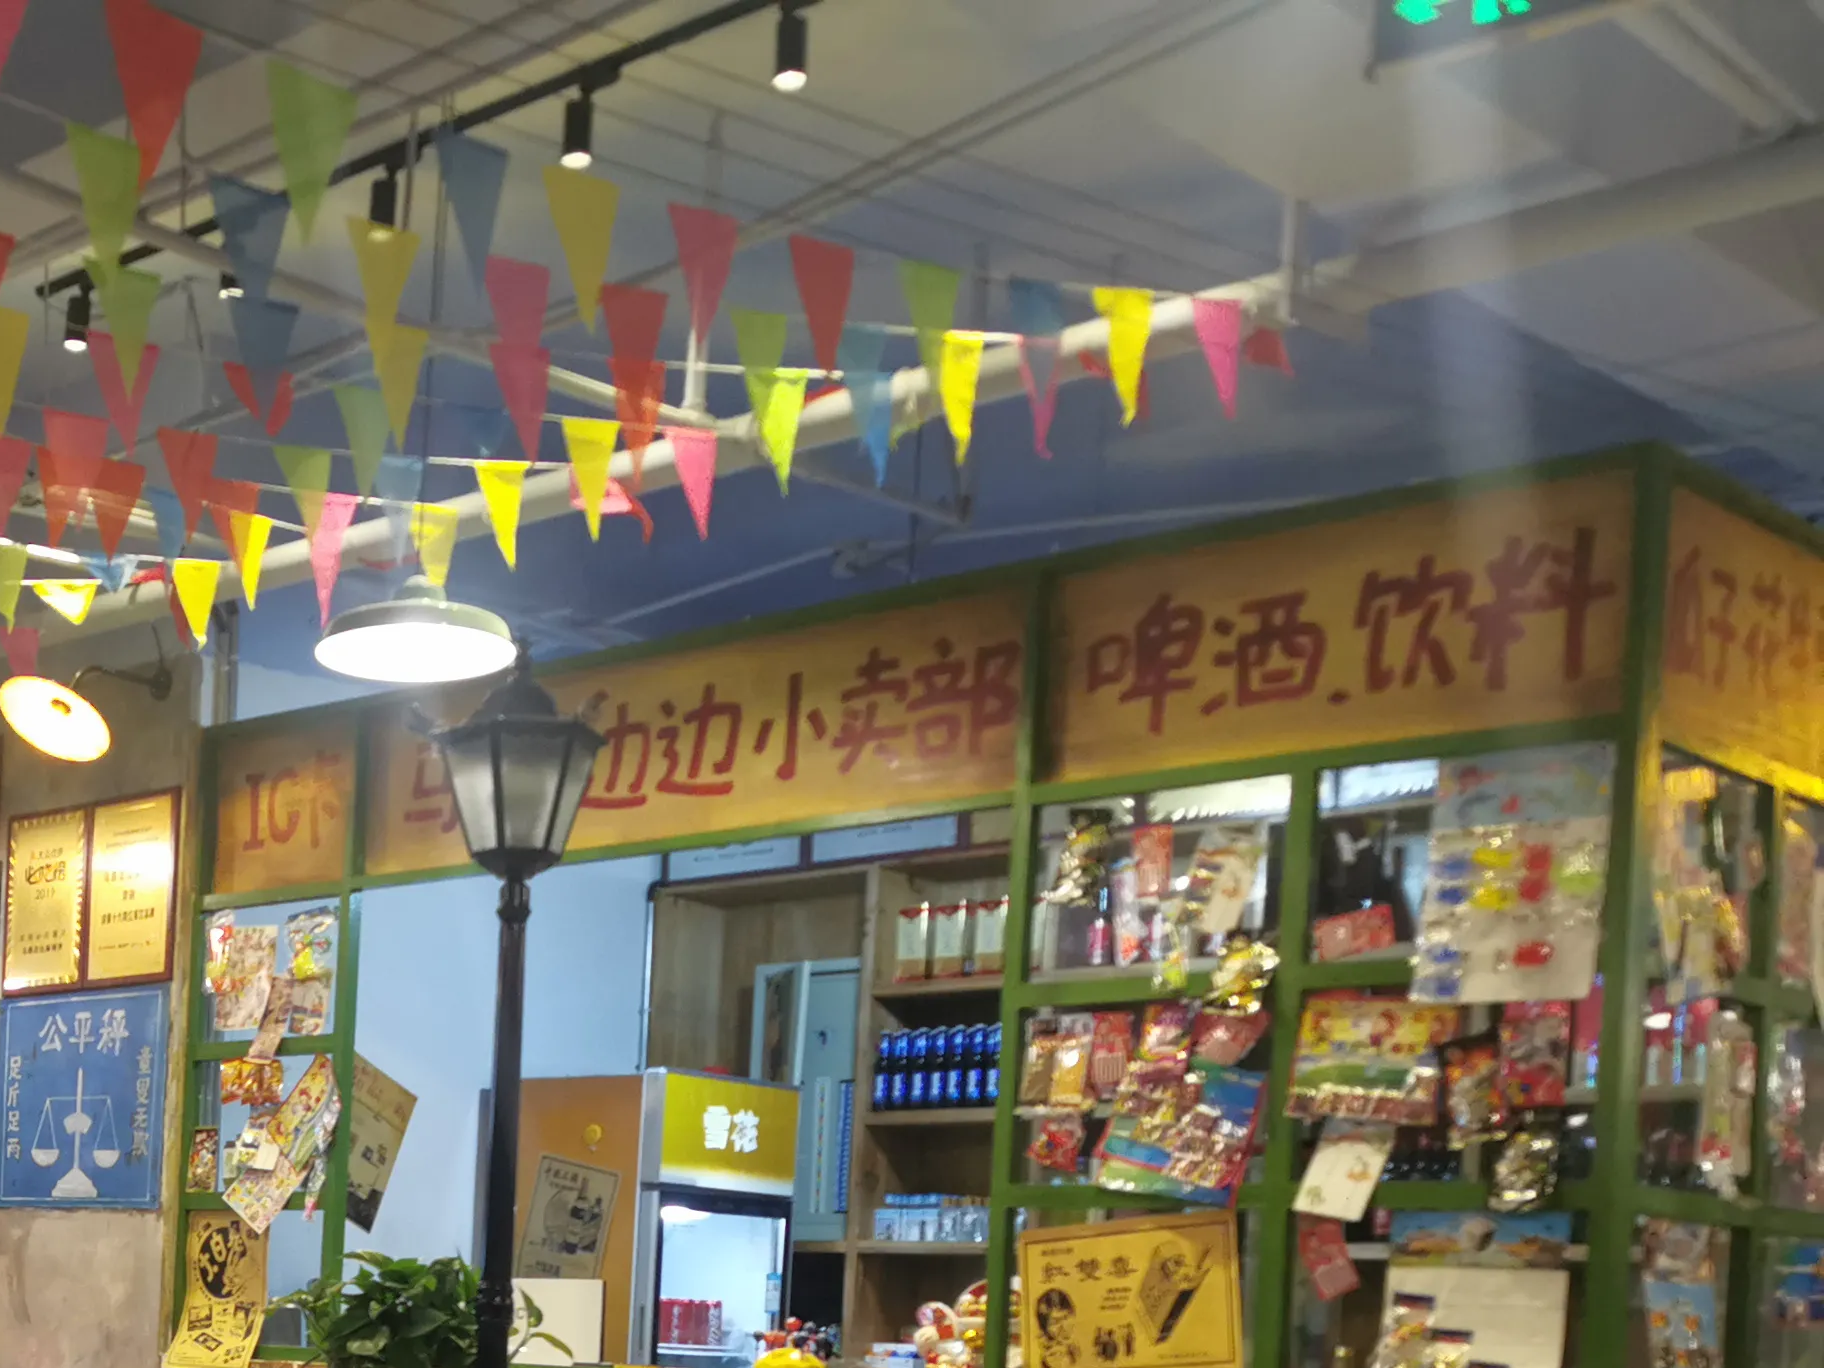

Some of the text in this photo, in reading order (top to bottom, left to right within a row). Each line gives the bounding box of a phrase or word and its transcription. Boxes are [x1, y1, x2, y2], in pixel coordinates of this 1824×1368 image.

[403, 637, 1024, 832] 马边边小卖部
[38, 1008, 130, 1057] 公平秤
[703, 1105, 760, 1153] 雪花
